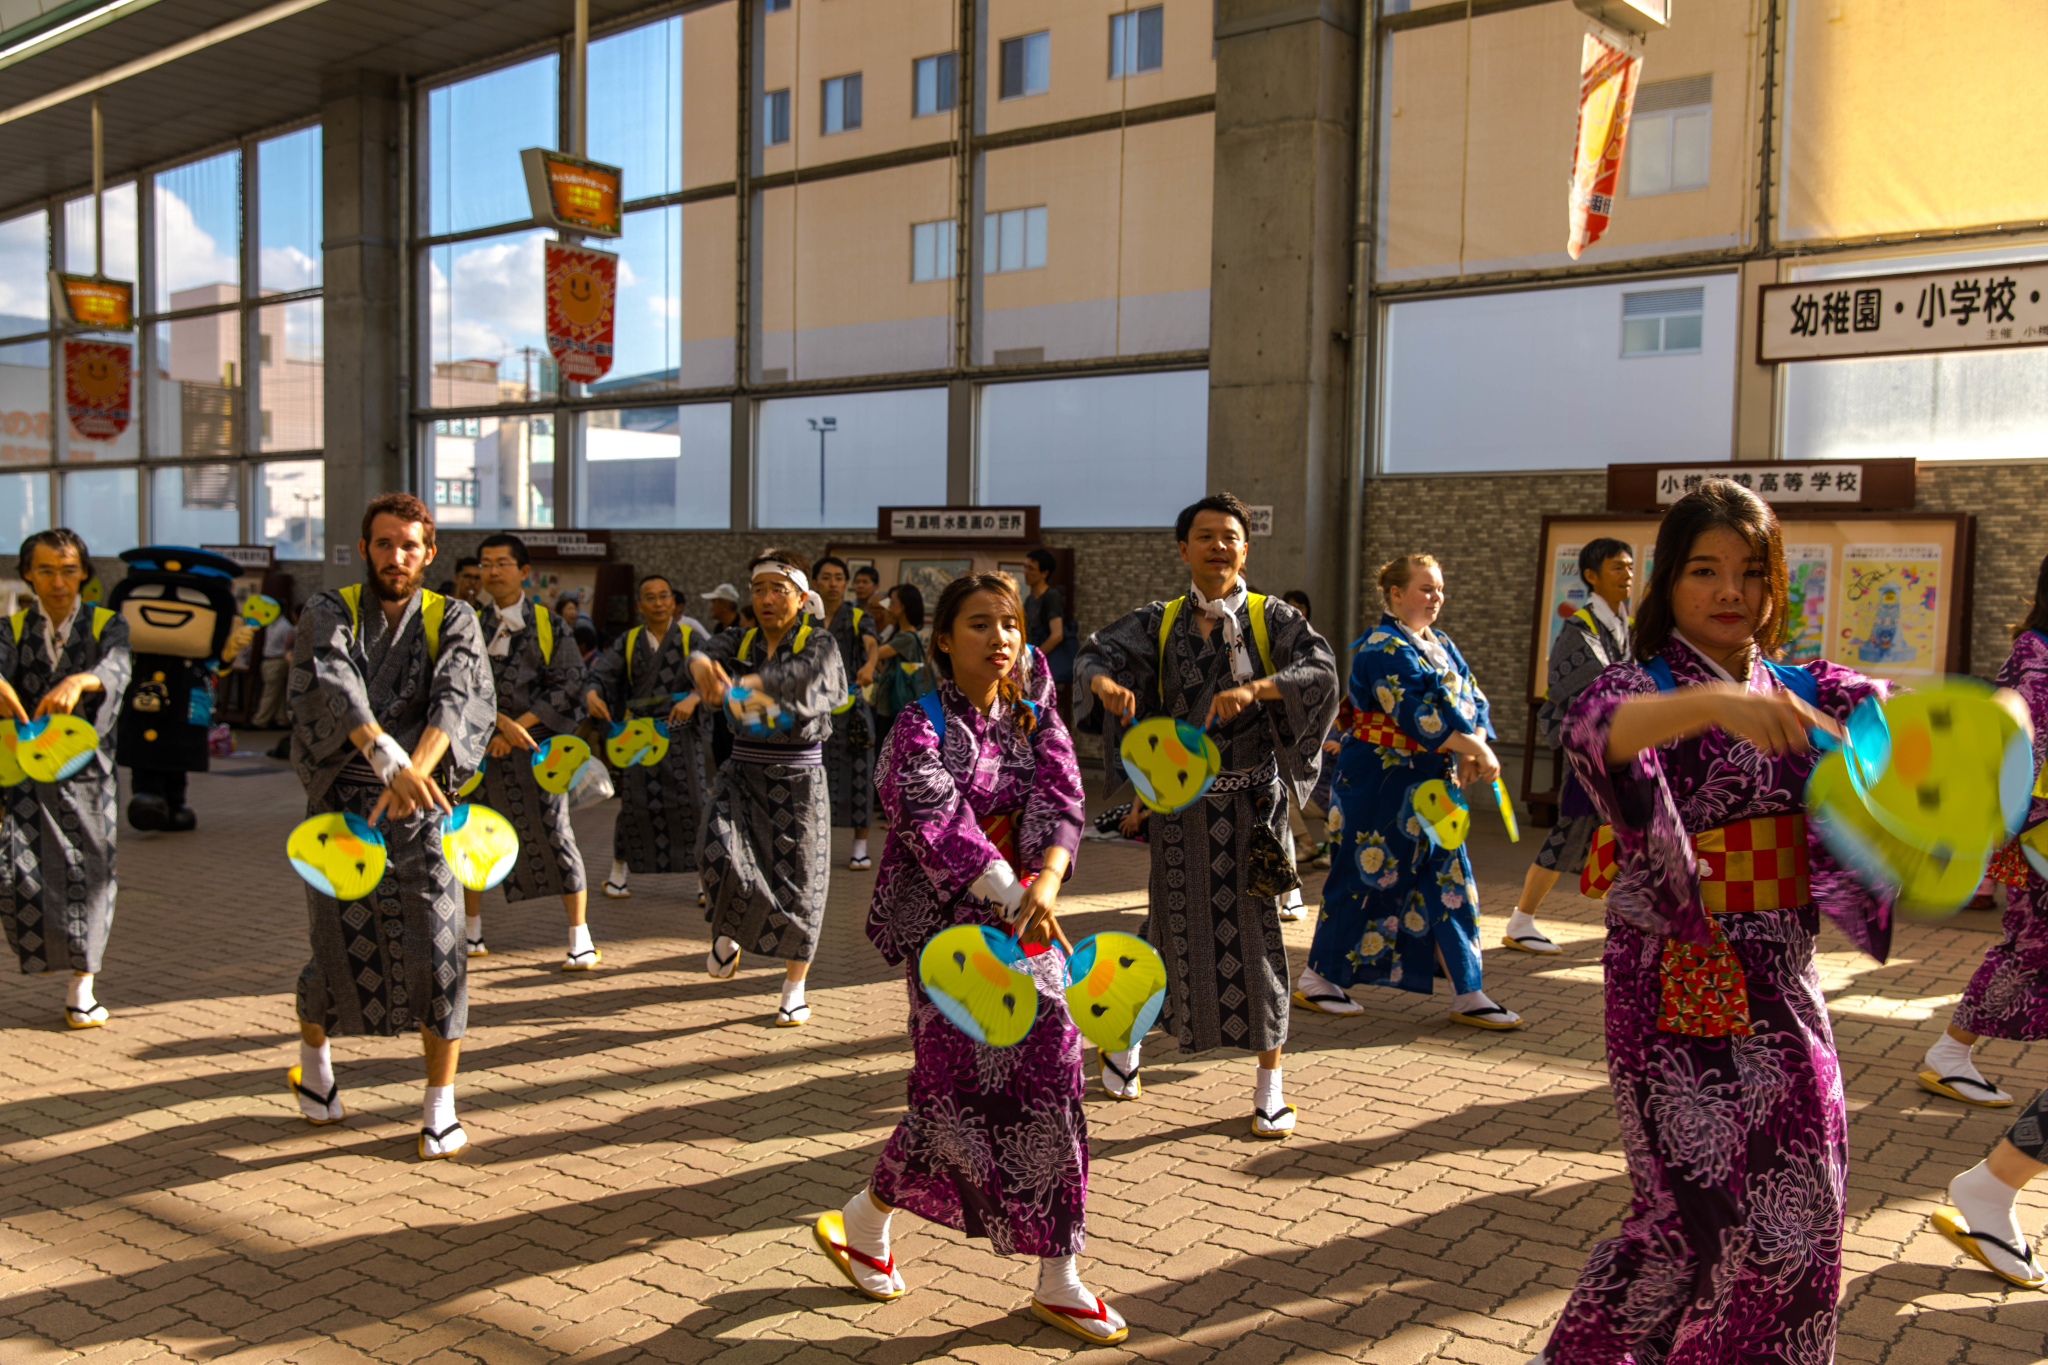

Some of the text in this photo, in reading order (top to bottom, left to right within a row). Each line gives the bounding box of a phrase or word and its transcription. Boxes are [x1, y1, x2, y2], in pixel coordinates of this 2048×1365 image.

[1790, 276, 2041, 337] 幼稚園・小学校・
[1986, 327, 2013, 341] 主催
[1660, 471, 1858, 494] 小樽陵高等学校
